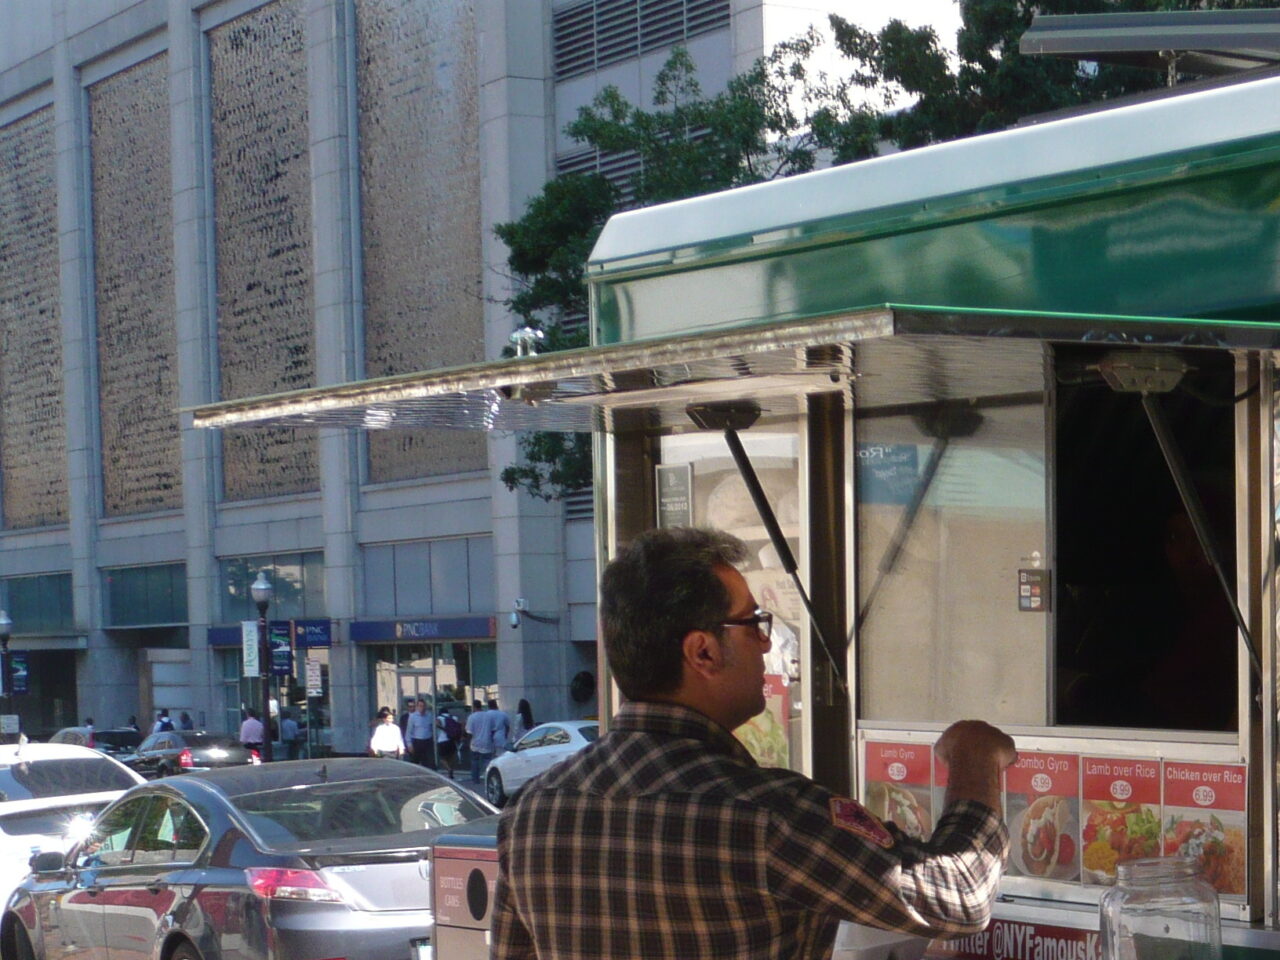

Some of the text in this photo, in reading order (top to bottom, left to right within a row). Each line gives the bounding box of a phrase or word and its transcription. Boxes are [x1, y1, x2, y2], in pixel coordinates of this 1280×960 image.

[305, 625, 323, 634] PNC
[880, 748, 915, 760] Lamb Gyro
[1014, 756, 1069, 772] Combo Gyro
[1086, 761, 1156, 779] Lamb over Rice
[1166, 767, 1243, 784] Chicken over Rice
[1033, 777, 1050, 788] 5.99
[1111, 784, 1130, 797] 6.99
[1194, 790, 1214, 802] 6.99
